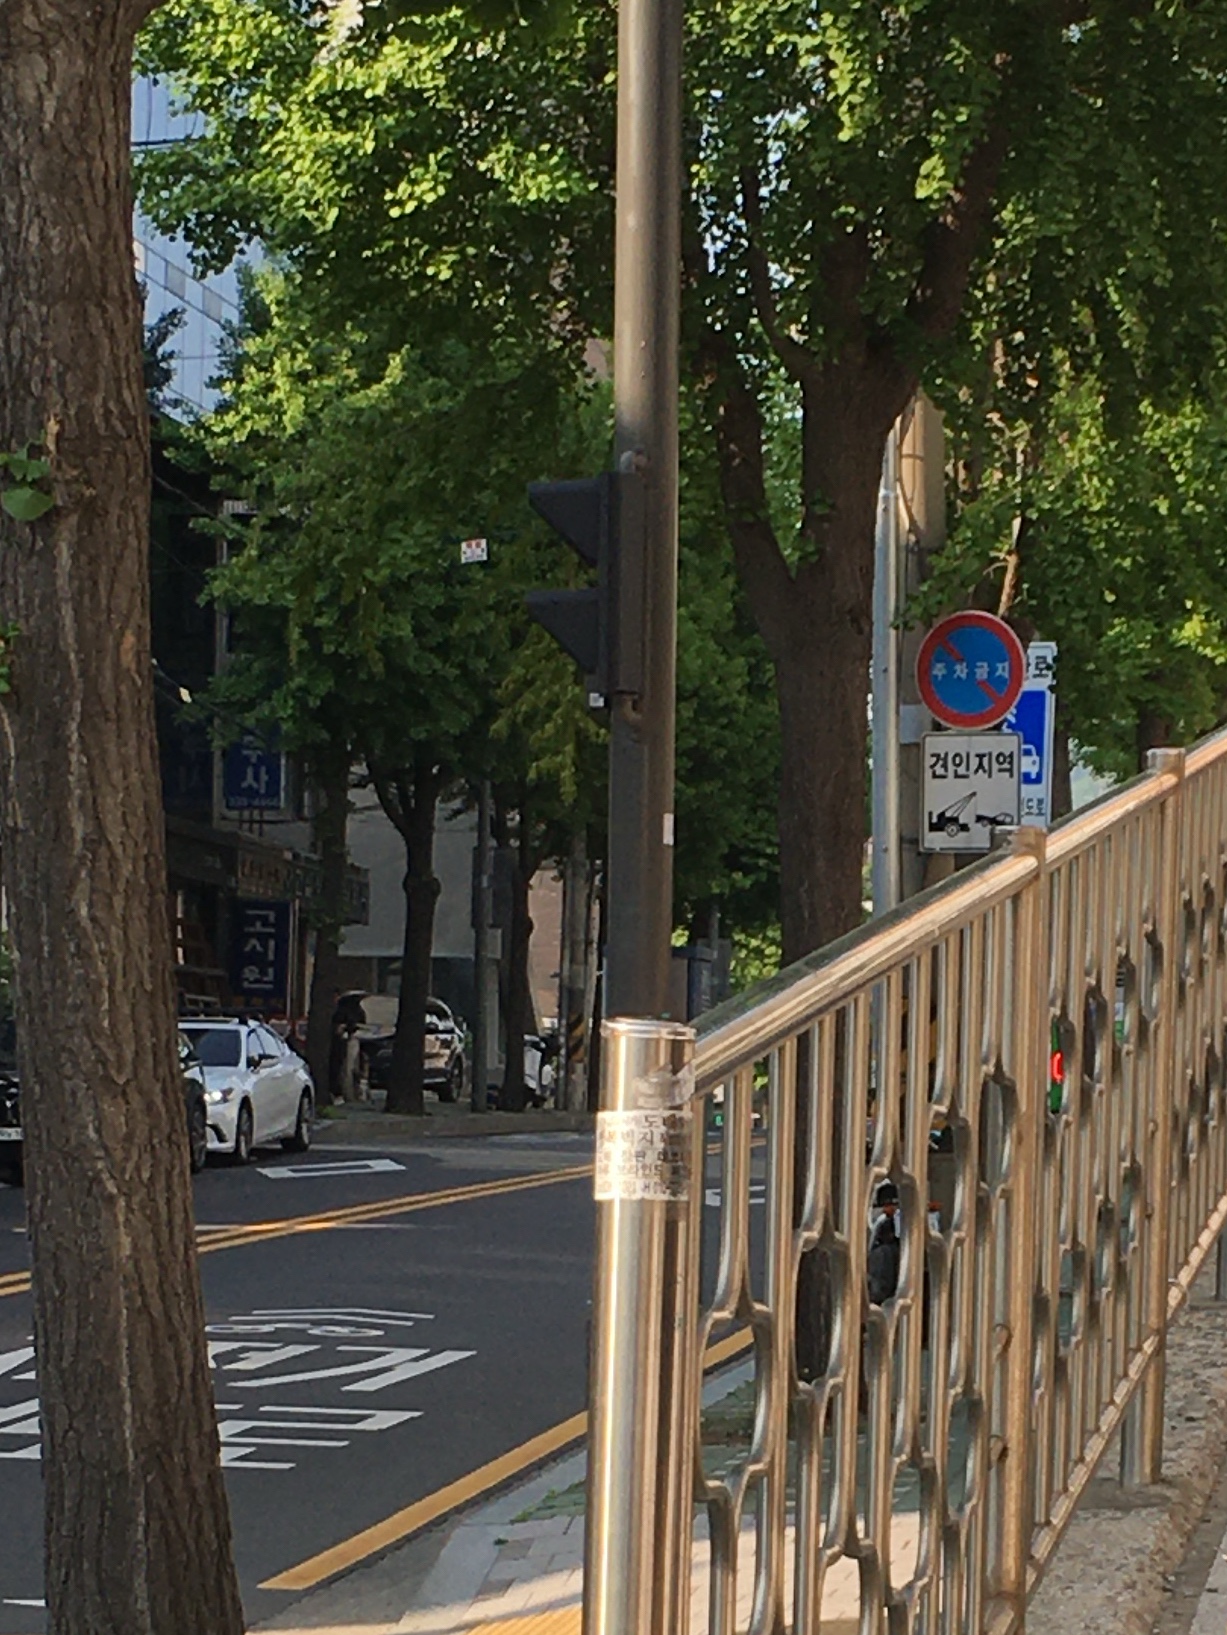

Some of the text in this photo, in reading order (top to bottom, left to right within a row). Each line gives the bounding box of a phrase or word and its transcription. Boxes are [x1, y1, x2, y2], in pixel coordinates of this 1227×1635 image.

[931, 661, 1010, 682] 주차금지
[928, 752, 1015, 779] 견인지역
[243, 909, 276, 989] 고시원
